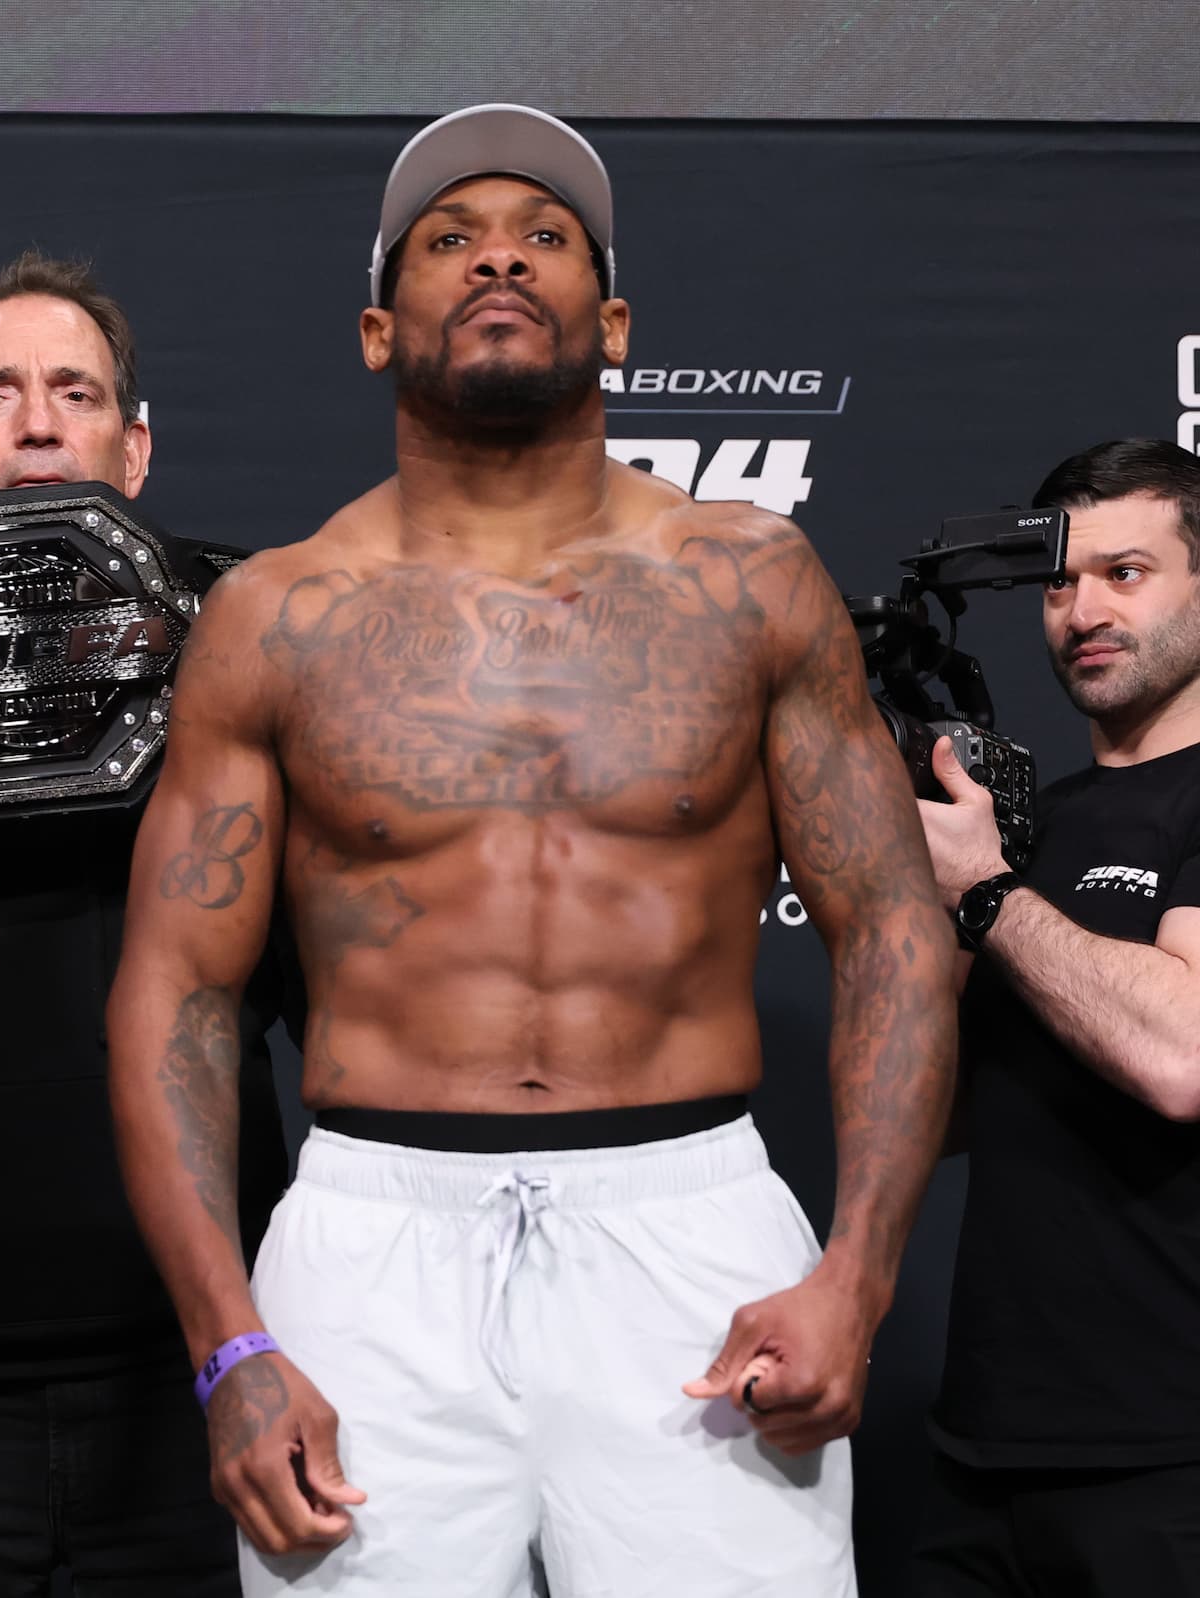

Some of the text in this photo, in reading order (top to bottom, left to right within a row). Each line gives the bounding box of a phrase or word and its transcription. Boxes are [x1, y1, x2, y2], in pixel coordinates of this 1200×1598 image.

[1017, 516, 1052, 527] SONY
[1081, 865, 1159, 889] ZUFFA
[1074, 880, 1157, 898] BOXING
